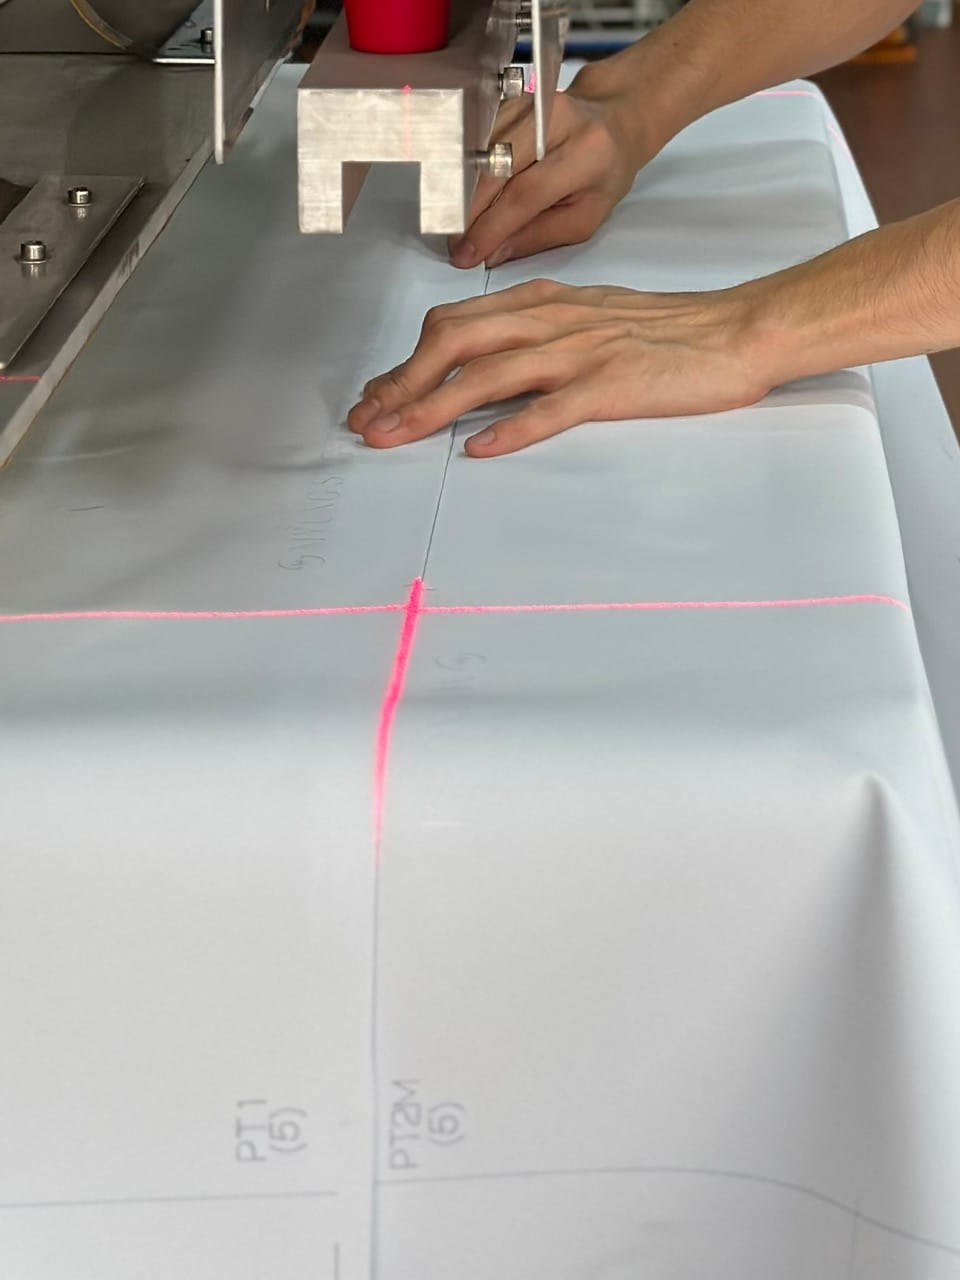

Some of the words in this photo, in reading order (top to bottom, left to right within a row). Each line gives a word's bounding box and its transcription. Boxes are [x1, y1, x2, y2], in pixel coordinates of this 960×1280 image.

[235, 1099, 268, 1163] PT1
[268, 1106, 308, 1154] (5)
[389, 1079, 422, 1170] PT2M
[427, 1101, 466, 1147] (5)
